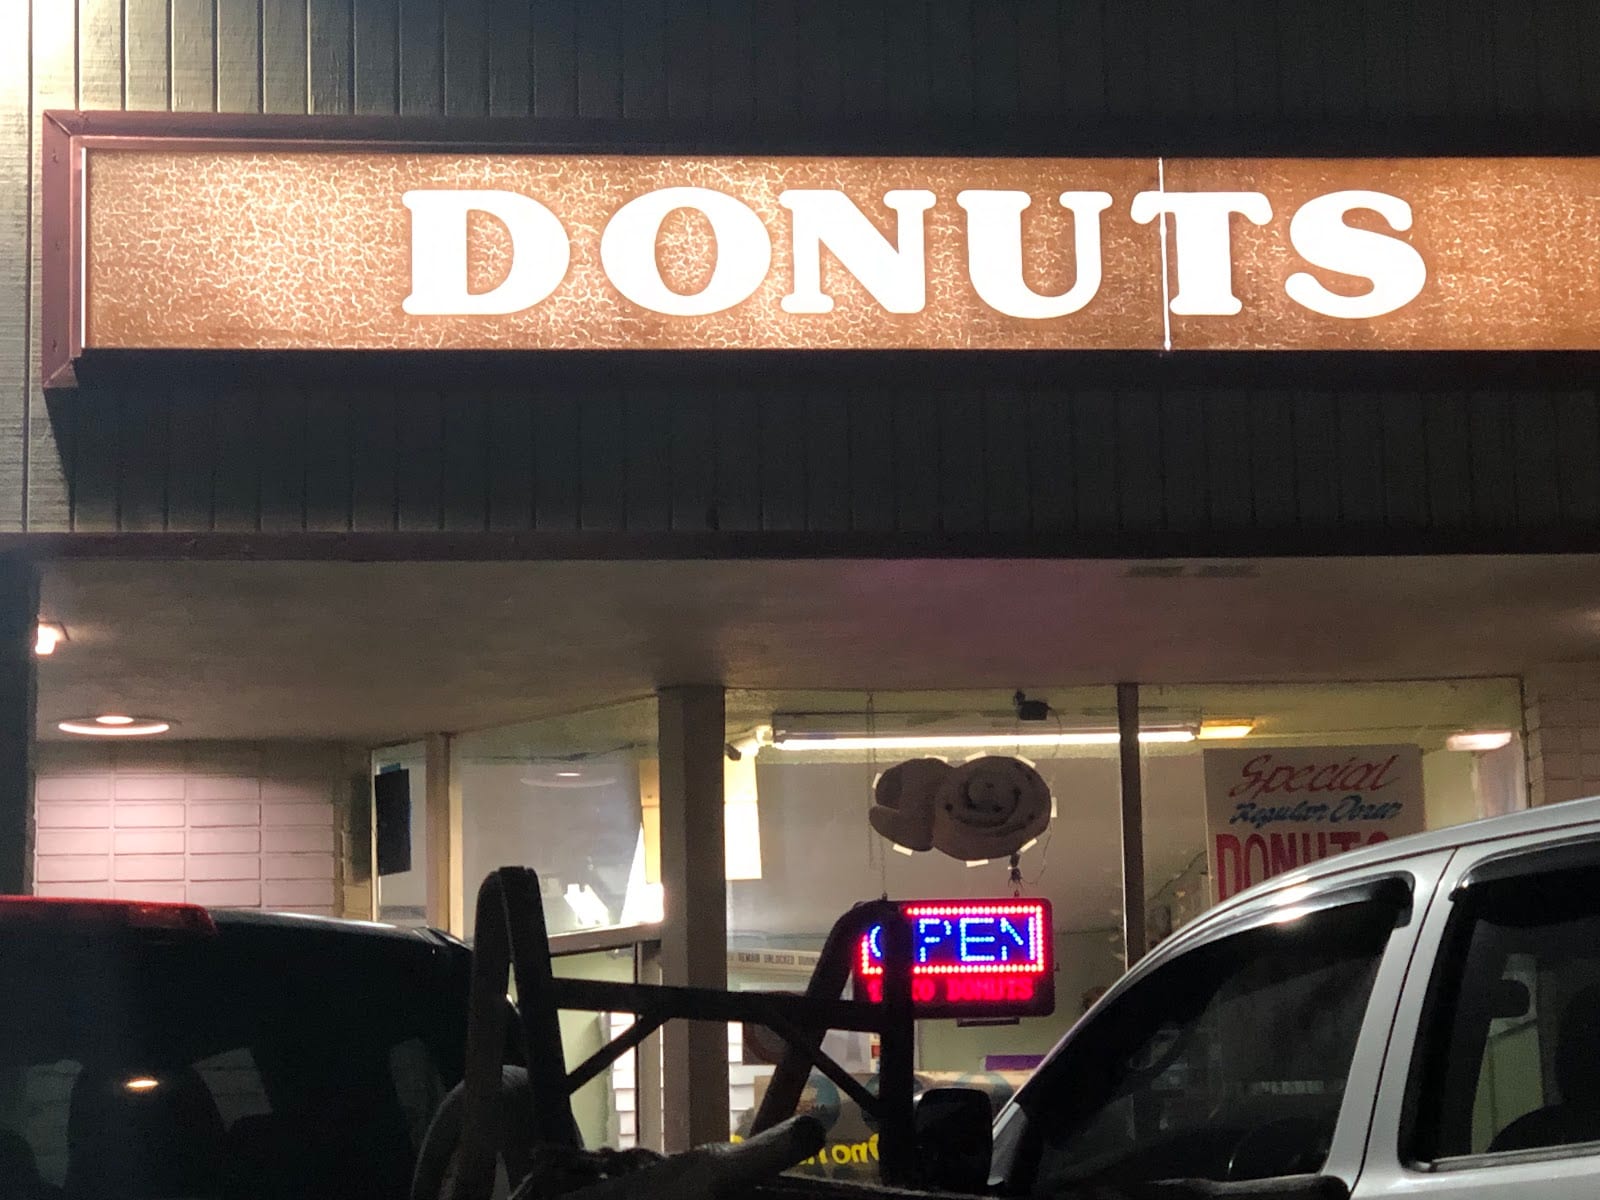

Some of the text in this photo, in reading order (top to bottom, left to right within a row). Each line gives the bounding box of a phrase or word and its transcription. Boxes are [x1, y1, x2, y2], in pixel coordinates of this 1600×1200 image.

[401, 187, 1427, 320] DONUTS
[1228, 754, 1400, 799] Special
[946, 977, 1035, 1001] DONUTS
